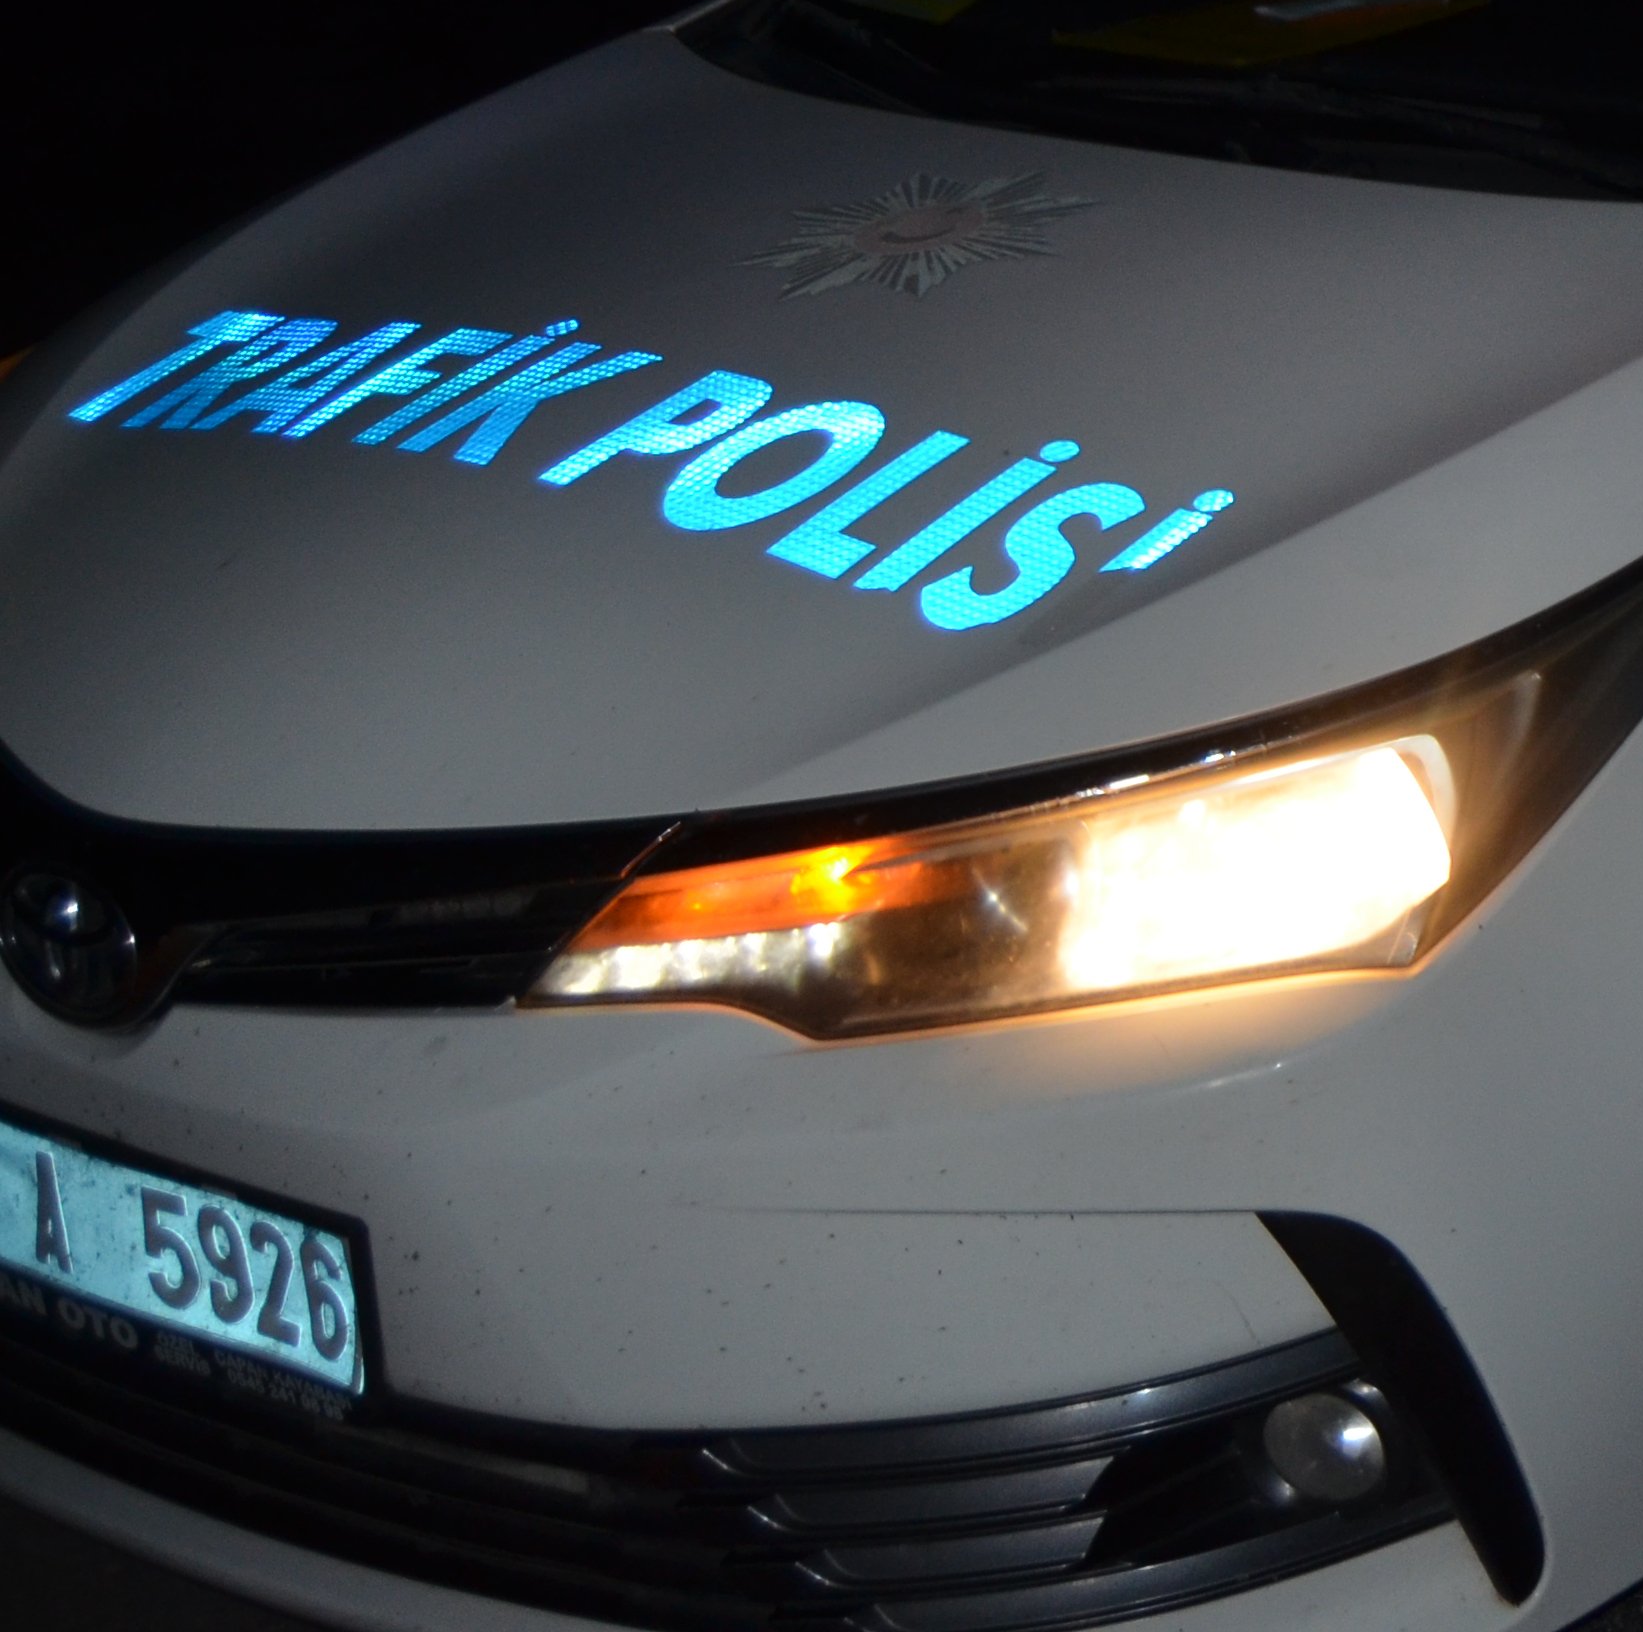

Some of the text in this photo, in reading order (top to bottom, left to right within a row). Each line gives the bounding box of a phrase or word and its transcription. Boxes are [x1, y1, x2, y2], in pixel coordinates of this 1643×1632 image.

[68, 310, 1236, 631] TRAFİK POLİSİ
[36, 1151, 349, 1361] A 5926
[57, 1296, 139, 1349] OTO
